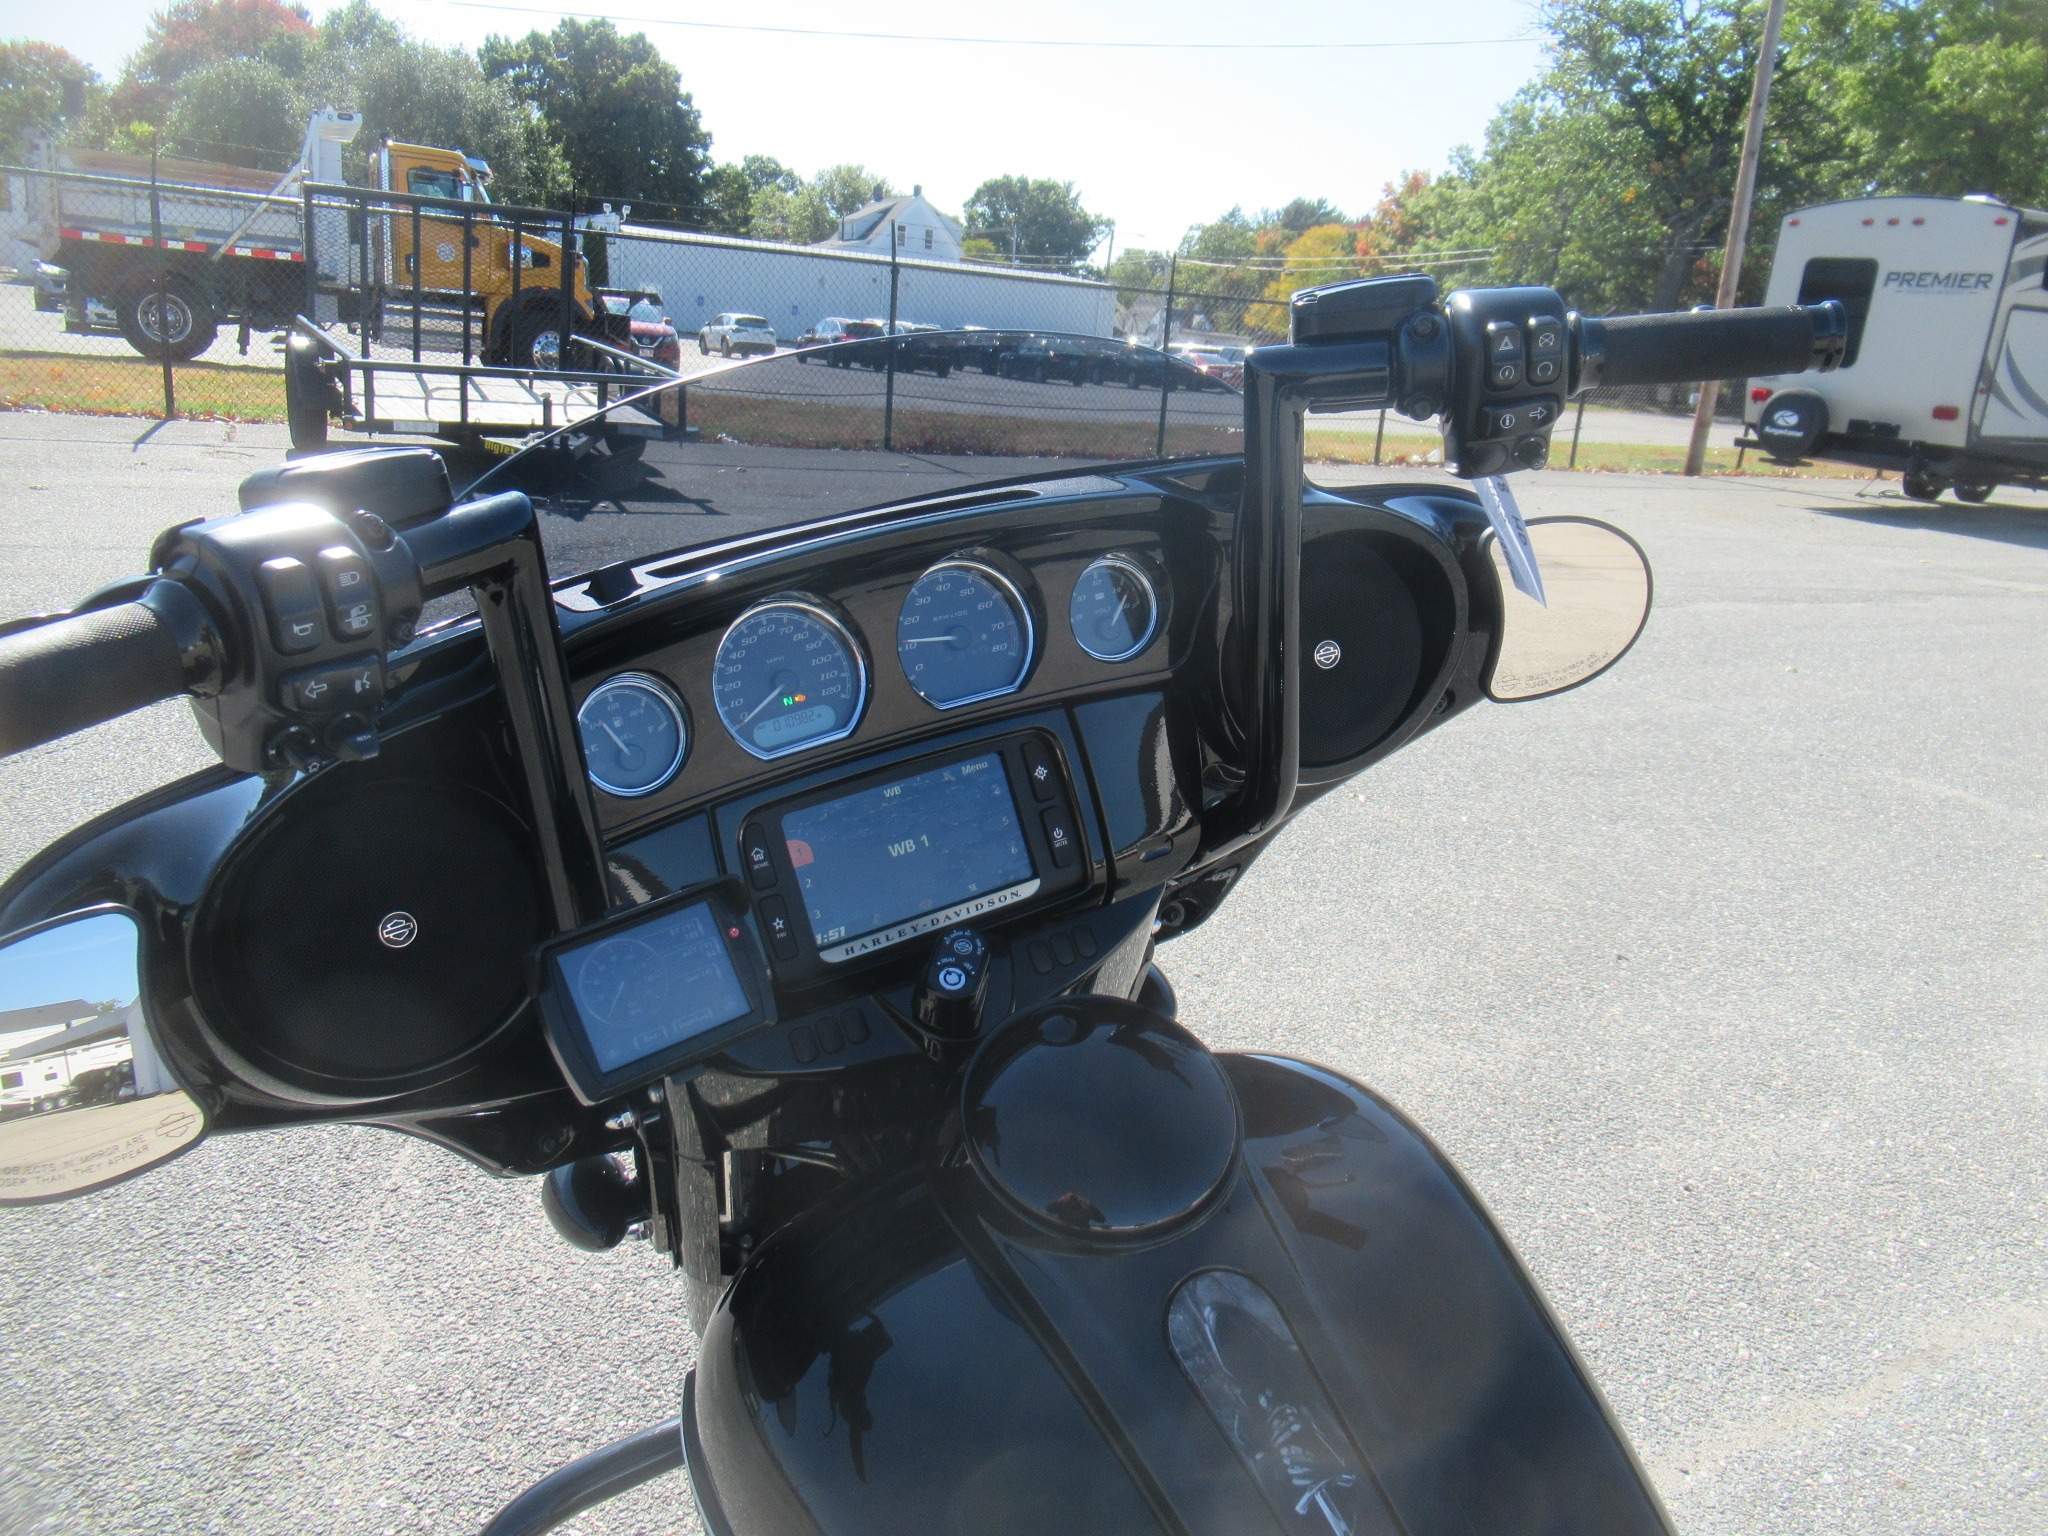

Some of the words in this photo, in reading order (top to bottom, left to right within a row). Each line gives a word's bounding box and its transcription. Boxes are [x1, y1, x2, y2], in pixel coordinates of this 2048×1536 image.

[1884, 272, 1994, 289] PREMIER
[935, 584, 950, 592] 40
[960, 588, 975, 596] 50
[916, 597, 930, 605] 30
[978, 601, 992, 610] 60
[904, 616, 919, 625] 20
[933, 614, 949, 622] RPM
[758, 625, 775, 634] 60
[991, 622, 1004, 630] 70
[779, 626, 793, 636] 70
[741, 636, 757, 645] 50
[793, 631, 809, 641] 80
[806, 641, 821, 650] 90
[992, 644, 1007, 652] 80
[729, 650, 745, 659] 40
[811, 655, 832, 666] 100
[725, 664, 741, 674] 30
[820, 671, 837, 681] 110
[724, 681, 741, 691] 20
[821, 685, 841, 696] 120
[730, 699, 743, 708] 10
[783, 697, 793, 706] N
[740, 711, 748, 719] 0
[648, 725, 655, 733] F
[591, 744, 599, 752] E
[961, 761, 988, 775] Menu
[884, 786, 901, 798] WB
[994, 787, 1000, 795] 4
[1002, 816, 1009, 826] 5
[888, 839, 916, 857] WB
[920, 835, 929, 847] 1
[1054, 840, 1068, 848] MUTE
[1011, 845, 1018, 854] 6
[806, 878, 812, 888] 2
[814, 909, 821, 919] 3
[844, 889, 1021, 957] HARLEY-DAVIDSON
[777, 931, 787, 939] FAV
[815, 925, 846, 945] 1:51
[126, 1133, 147, 1148] ARE
[36, 1173, 66, 1185] THAN
[74, 1162, 102, 1178] THEY
[108, 1144, 150, 1167] APPEAR
